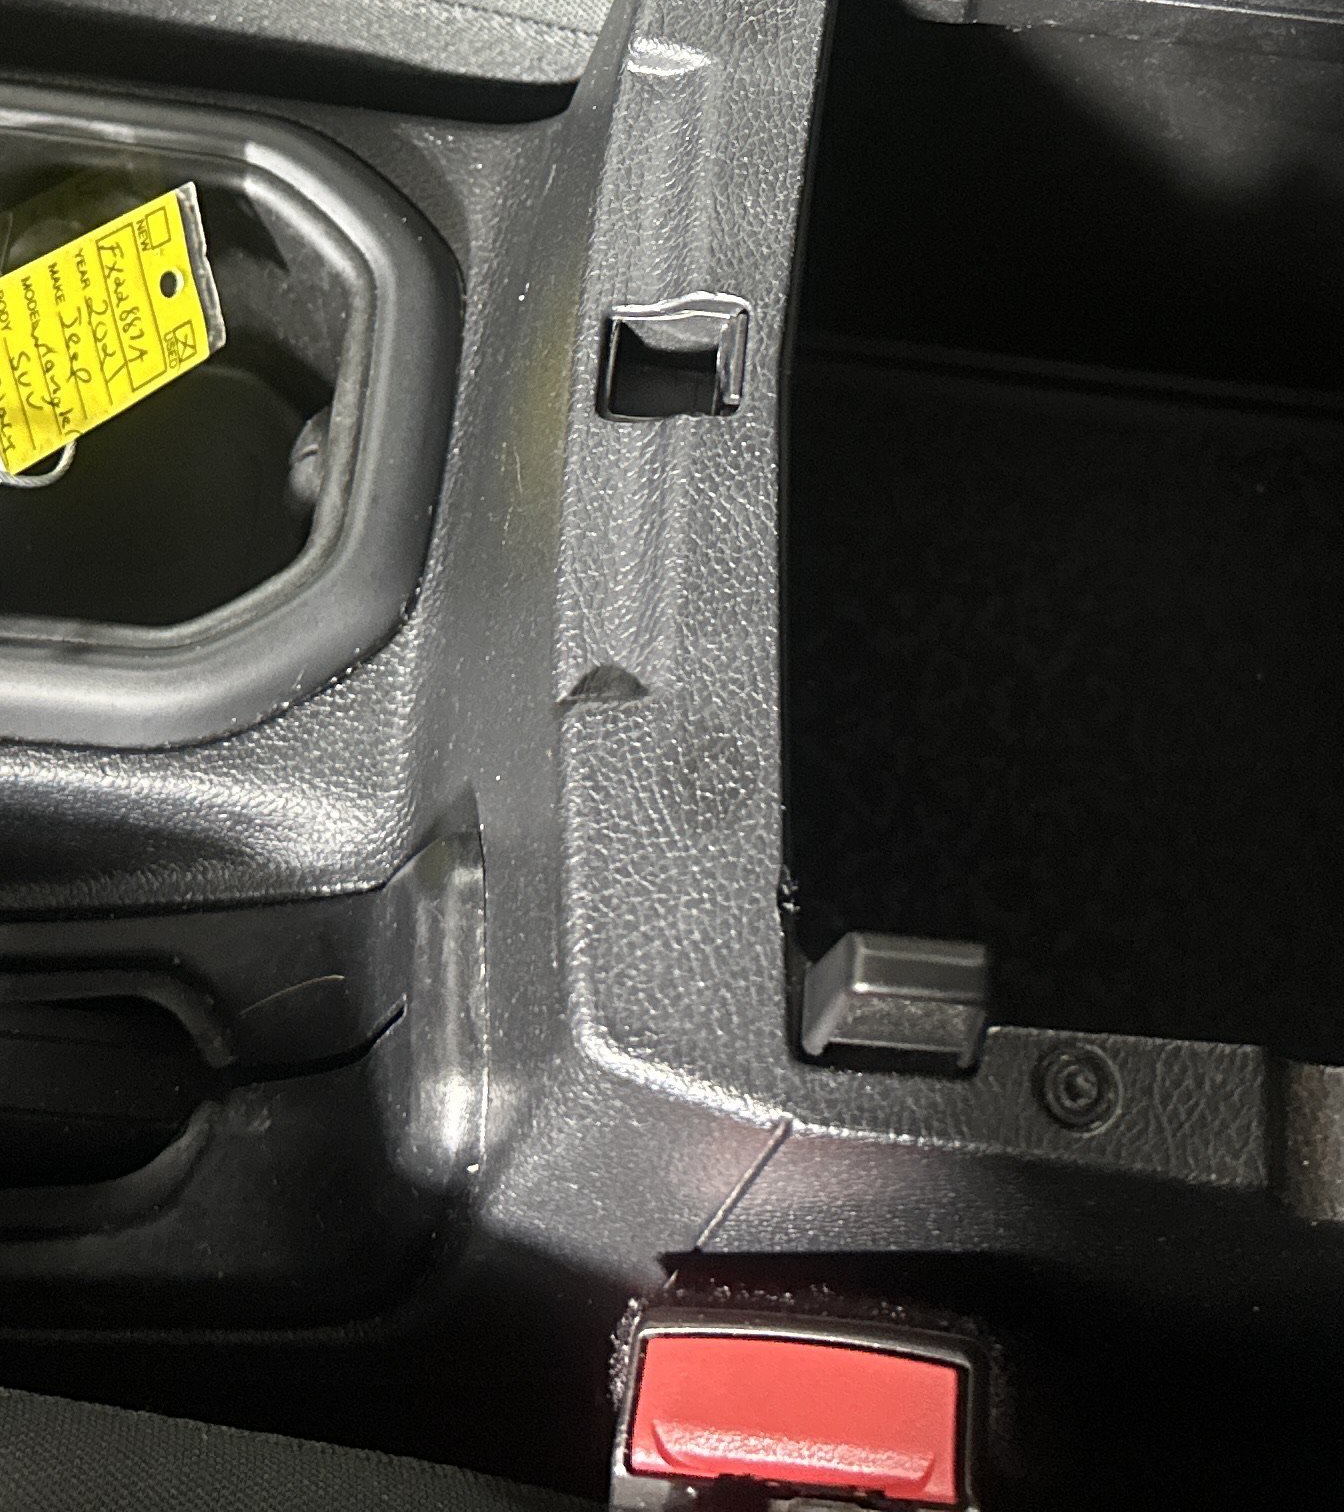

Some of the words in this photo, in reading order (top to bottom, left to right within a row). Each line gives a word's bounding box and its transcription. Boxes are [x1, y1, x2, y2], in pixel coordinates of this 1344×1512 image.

[135, 218, 153, 252] NEW
[48, 261, 66, 305] MAKE
[74, 247, 91, 291] YEAR
[86, 297, 128, 384] 2021
[162, 329, 180, 369] USED
